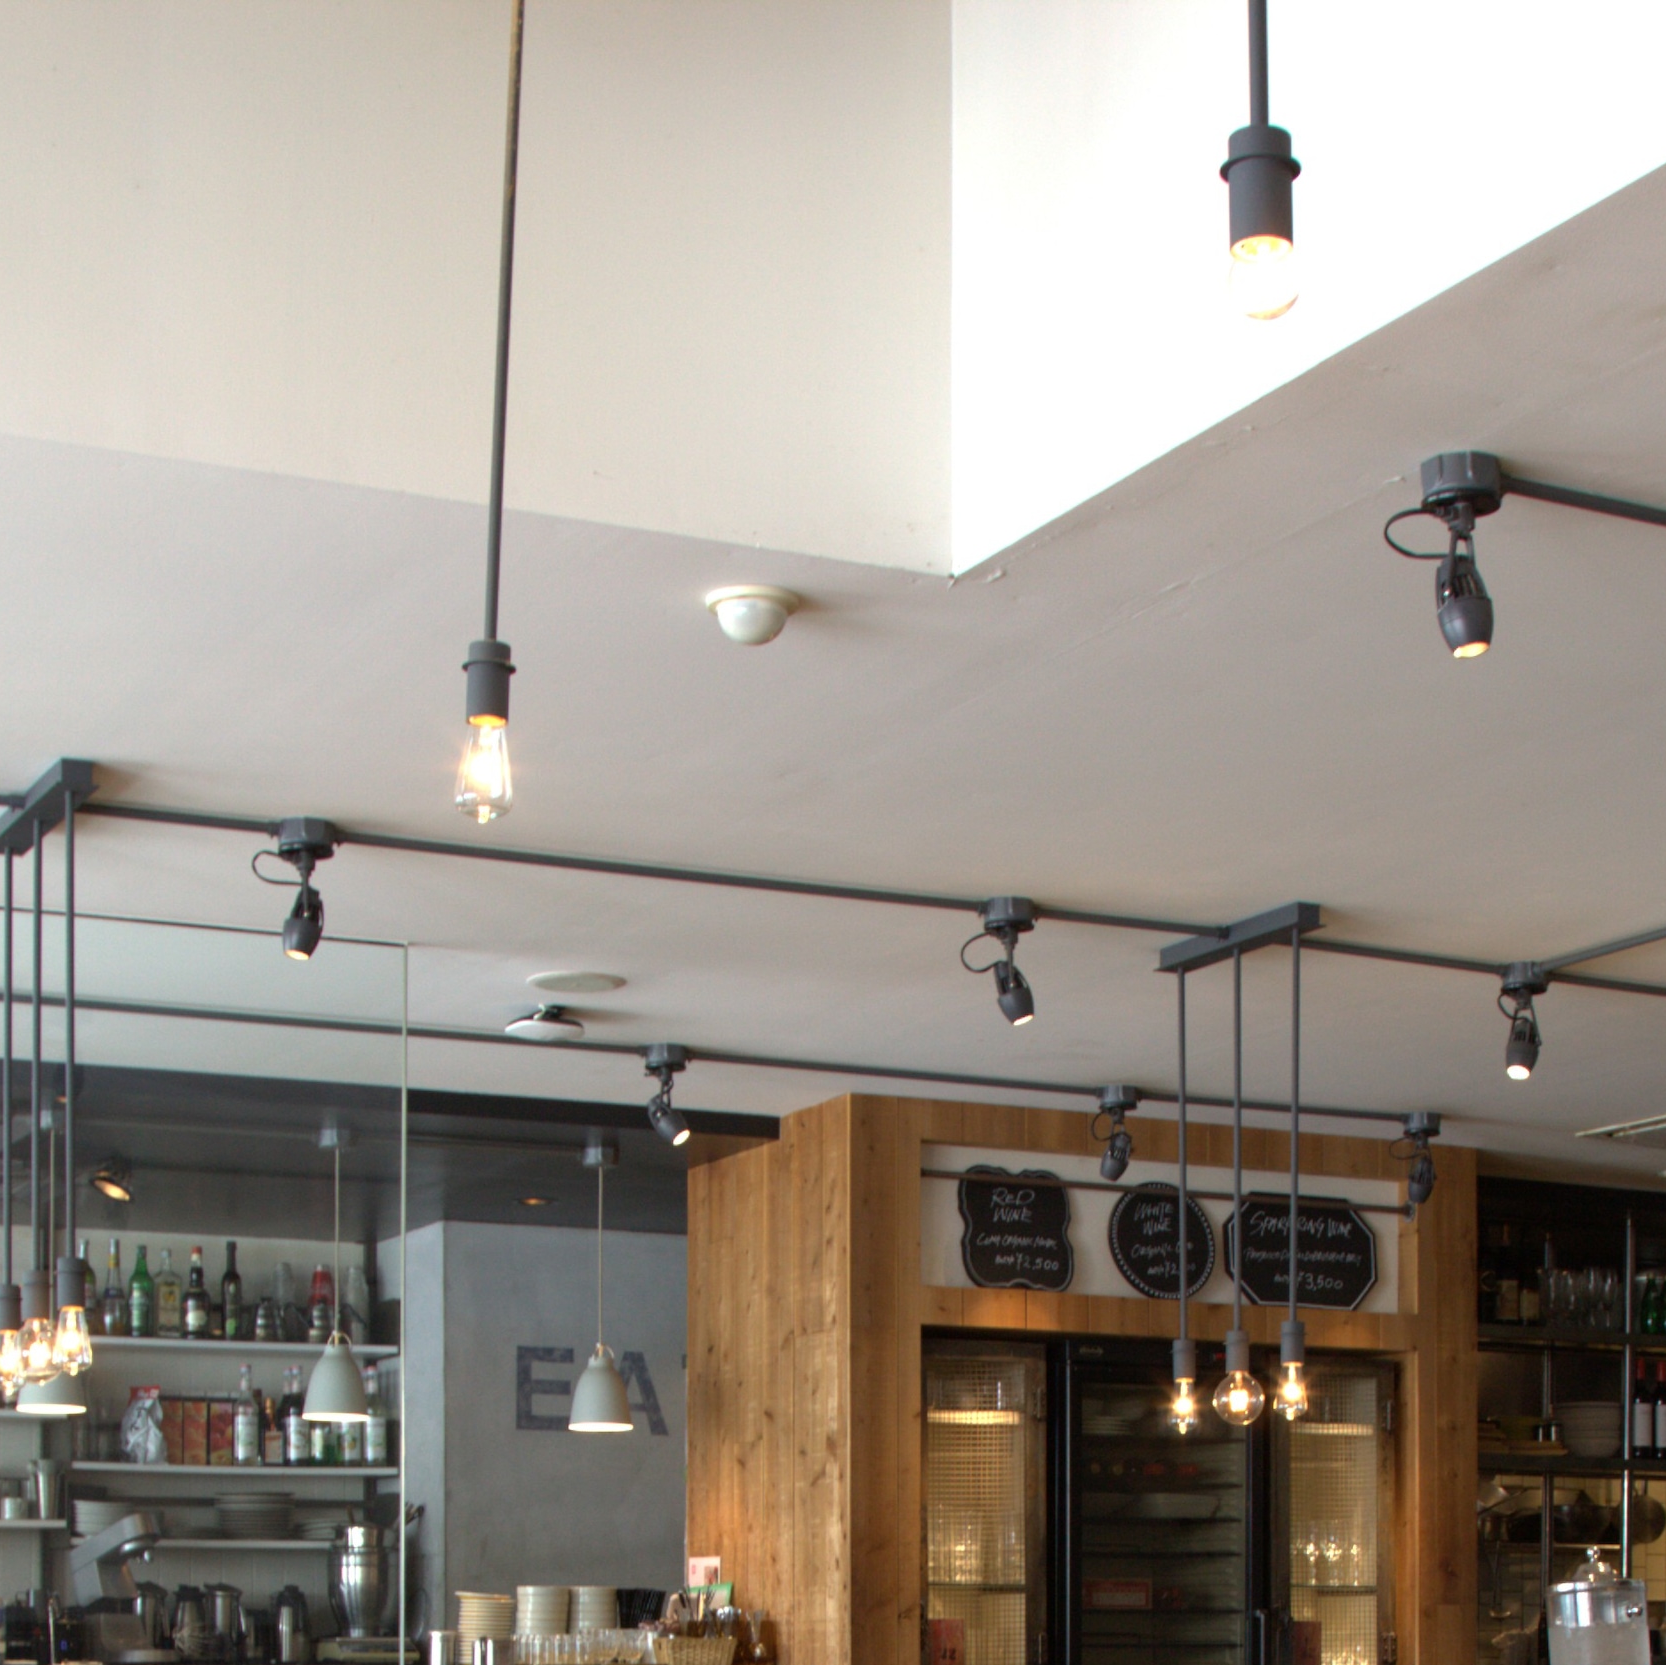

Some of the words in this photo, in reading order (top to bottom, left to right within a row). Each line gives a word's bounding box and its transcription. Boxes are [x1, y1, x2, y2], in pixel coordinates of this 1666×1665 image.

[991, 1187, 1035, 1208] RED
[993, 1207, 1033, 1223] WINE
[516, 1345, 687, 1436] EA
